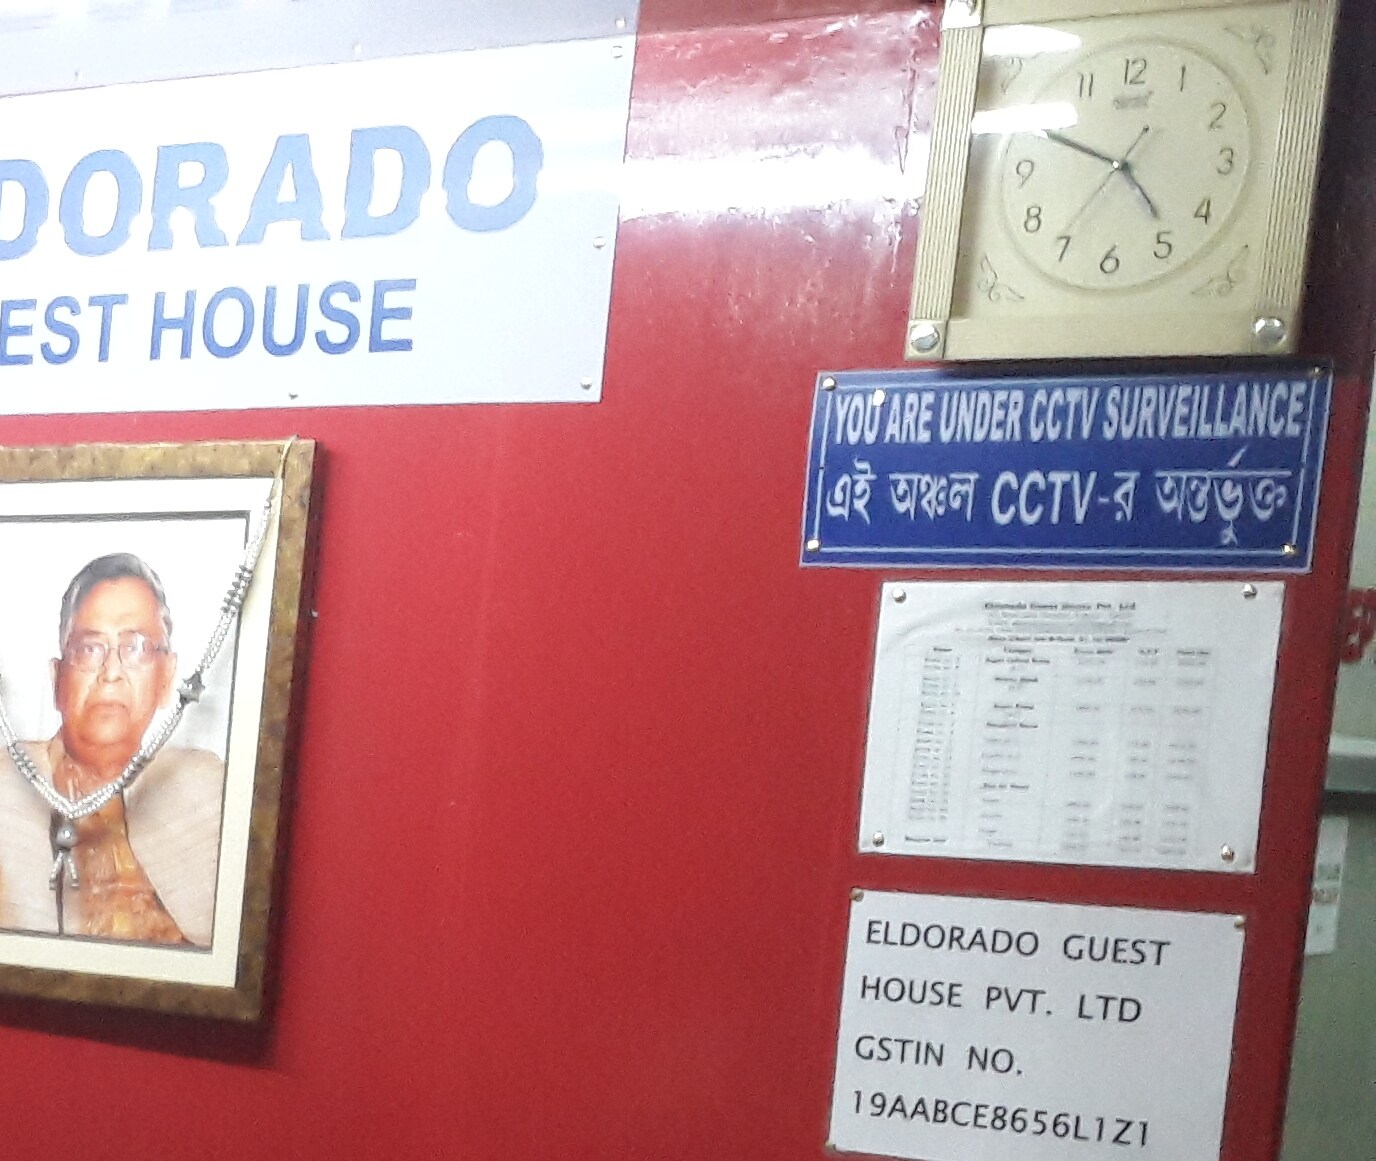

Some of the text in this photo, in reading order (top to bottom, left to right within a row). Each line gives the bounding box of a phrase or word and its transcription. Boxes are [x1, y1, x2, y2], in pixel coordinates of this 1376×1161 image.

[1077, 73, 1094, 98] 11
[1123, 57, 1147, 85] 12
[1208, 102, 1227, 131] 2
[1015, 159, 1035, 187] 9
[1217, 148, 1234, 175] 3
[1024, 206, 1042, 233] 8
[1194, 198, 1211, 225] 4
[1056, 235, 1073, 262] 7
[1099, 244, 1120, 274] 6
[1153, 231, 1173, 259] 5
[148, 279, 419, 361] HOUSE
[834, 380, 1306, 445] YOU ARE UNDER CCTV SURVEILLANCE
[825, 457, 878, 525] এই
[888, 469, 979, 524] অঞ্চল
[866, 919, 1171, 966] ELDORADO GUEST
[860, 975, 1142, 1023] HOUSE PVT. LTD
[855, 1035, 1023, 1076] GSTIN NO.
[853, 1090, 1149, 1147] 19AABCE8656L1Z1
